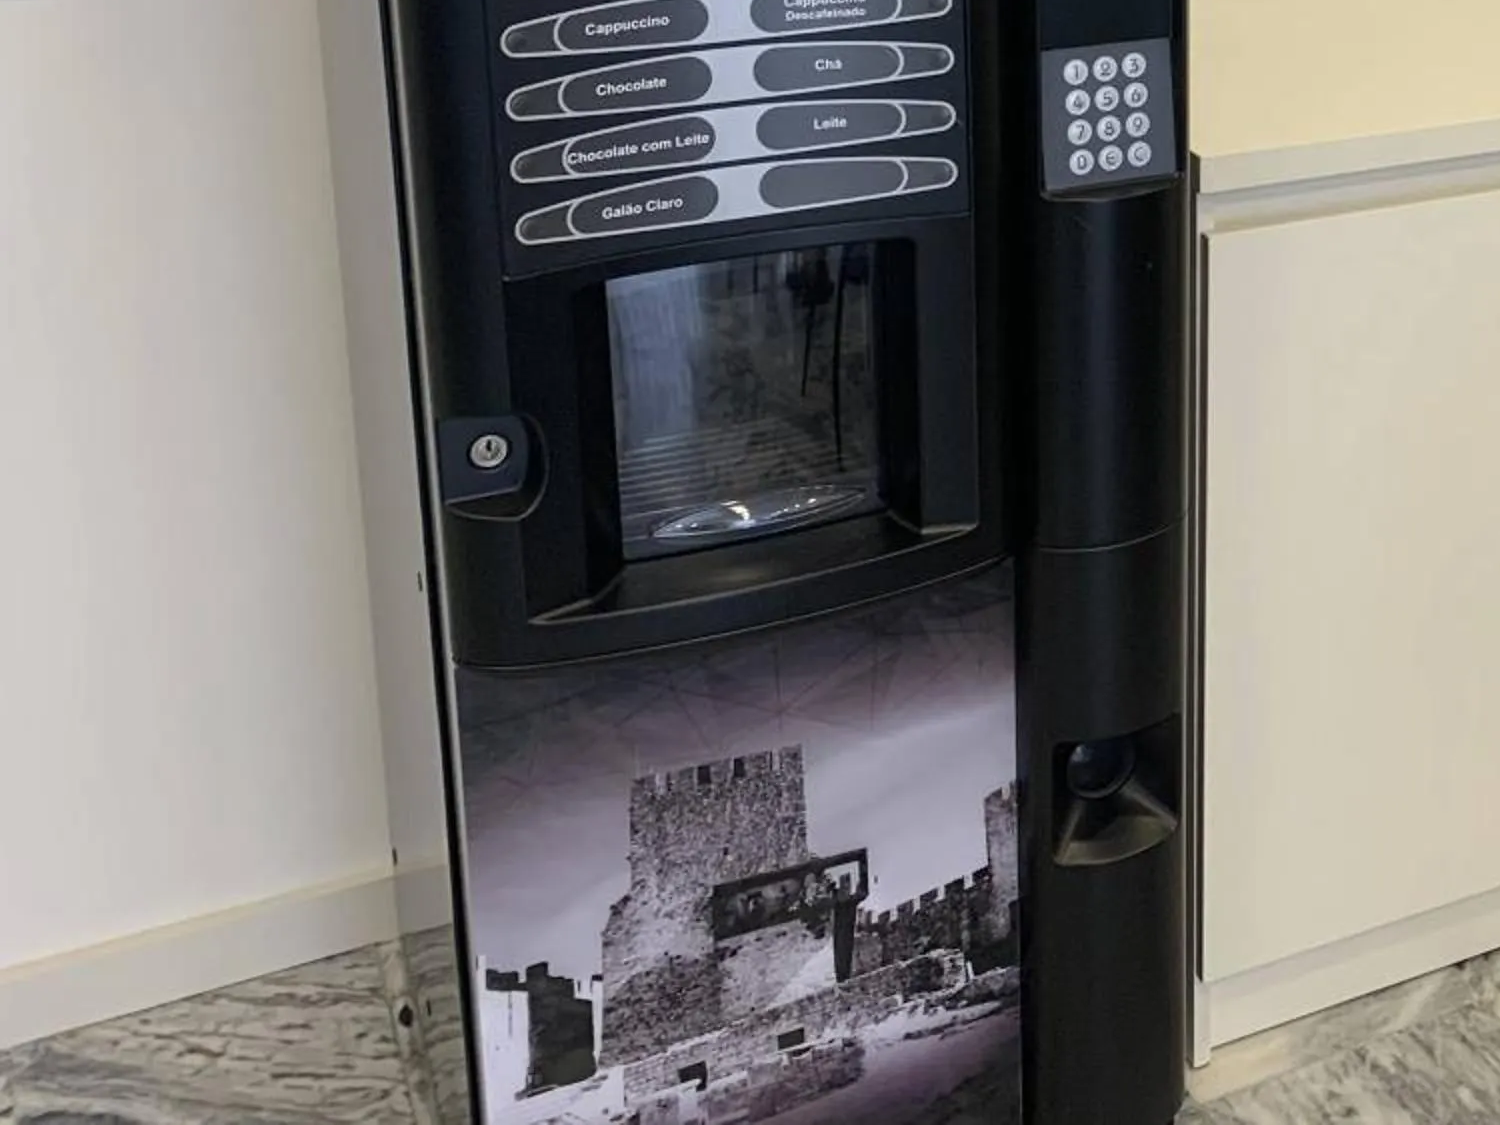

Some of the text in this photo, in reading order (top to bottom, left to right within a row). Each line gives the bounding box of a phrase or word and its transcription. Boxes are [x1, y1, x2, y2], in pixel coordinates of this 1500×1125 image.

[785, 7, 866, 21] Descafeinado
[585, 14, 669, 36] Cappuccino
[815, 57, 842, 71] Chá
[1129, 59, 1139, 73] 3
[596, 77, 667, 96] Chocolate
[1102, 92, 1112, 106] 5
[1131, 88, 1140, 102] 6
[814, 116, 847, 130] Leite
[1075, 117, 1142, 140] 7 8 9
[568, 132, 710, 165] Chocolate com Leite
[602, 198, 683, 219] Galão Claro
